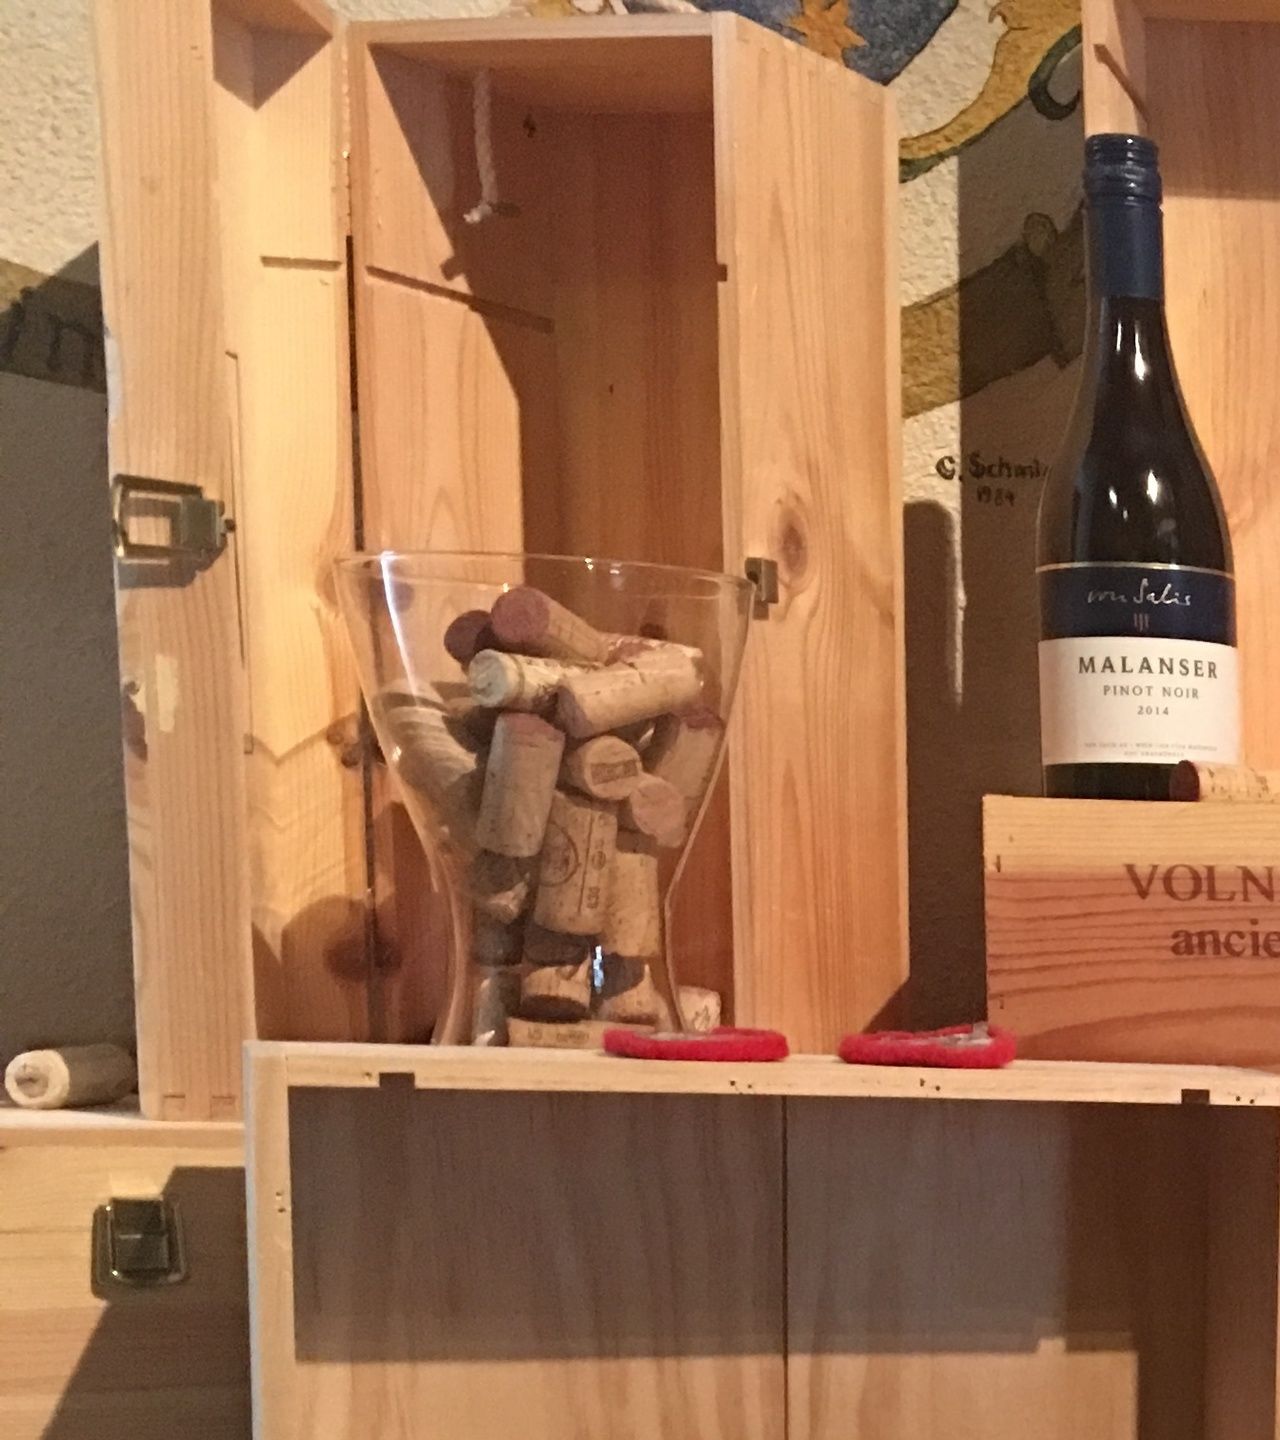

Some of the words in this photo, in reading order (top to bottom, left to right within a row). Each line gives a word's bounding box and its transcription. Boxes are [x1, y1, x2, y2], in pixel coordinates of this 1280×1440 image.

[1078, 655, 1218, 680] MALANSER
[1103, 684, 1154, 698] PINOT
[1162, 686, 1200, 700] NOIR
[1137, 705, 1170, 717] 2014
